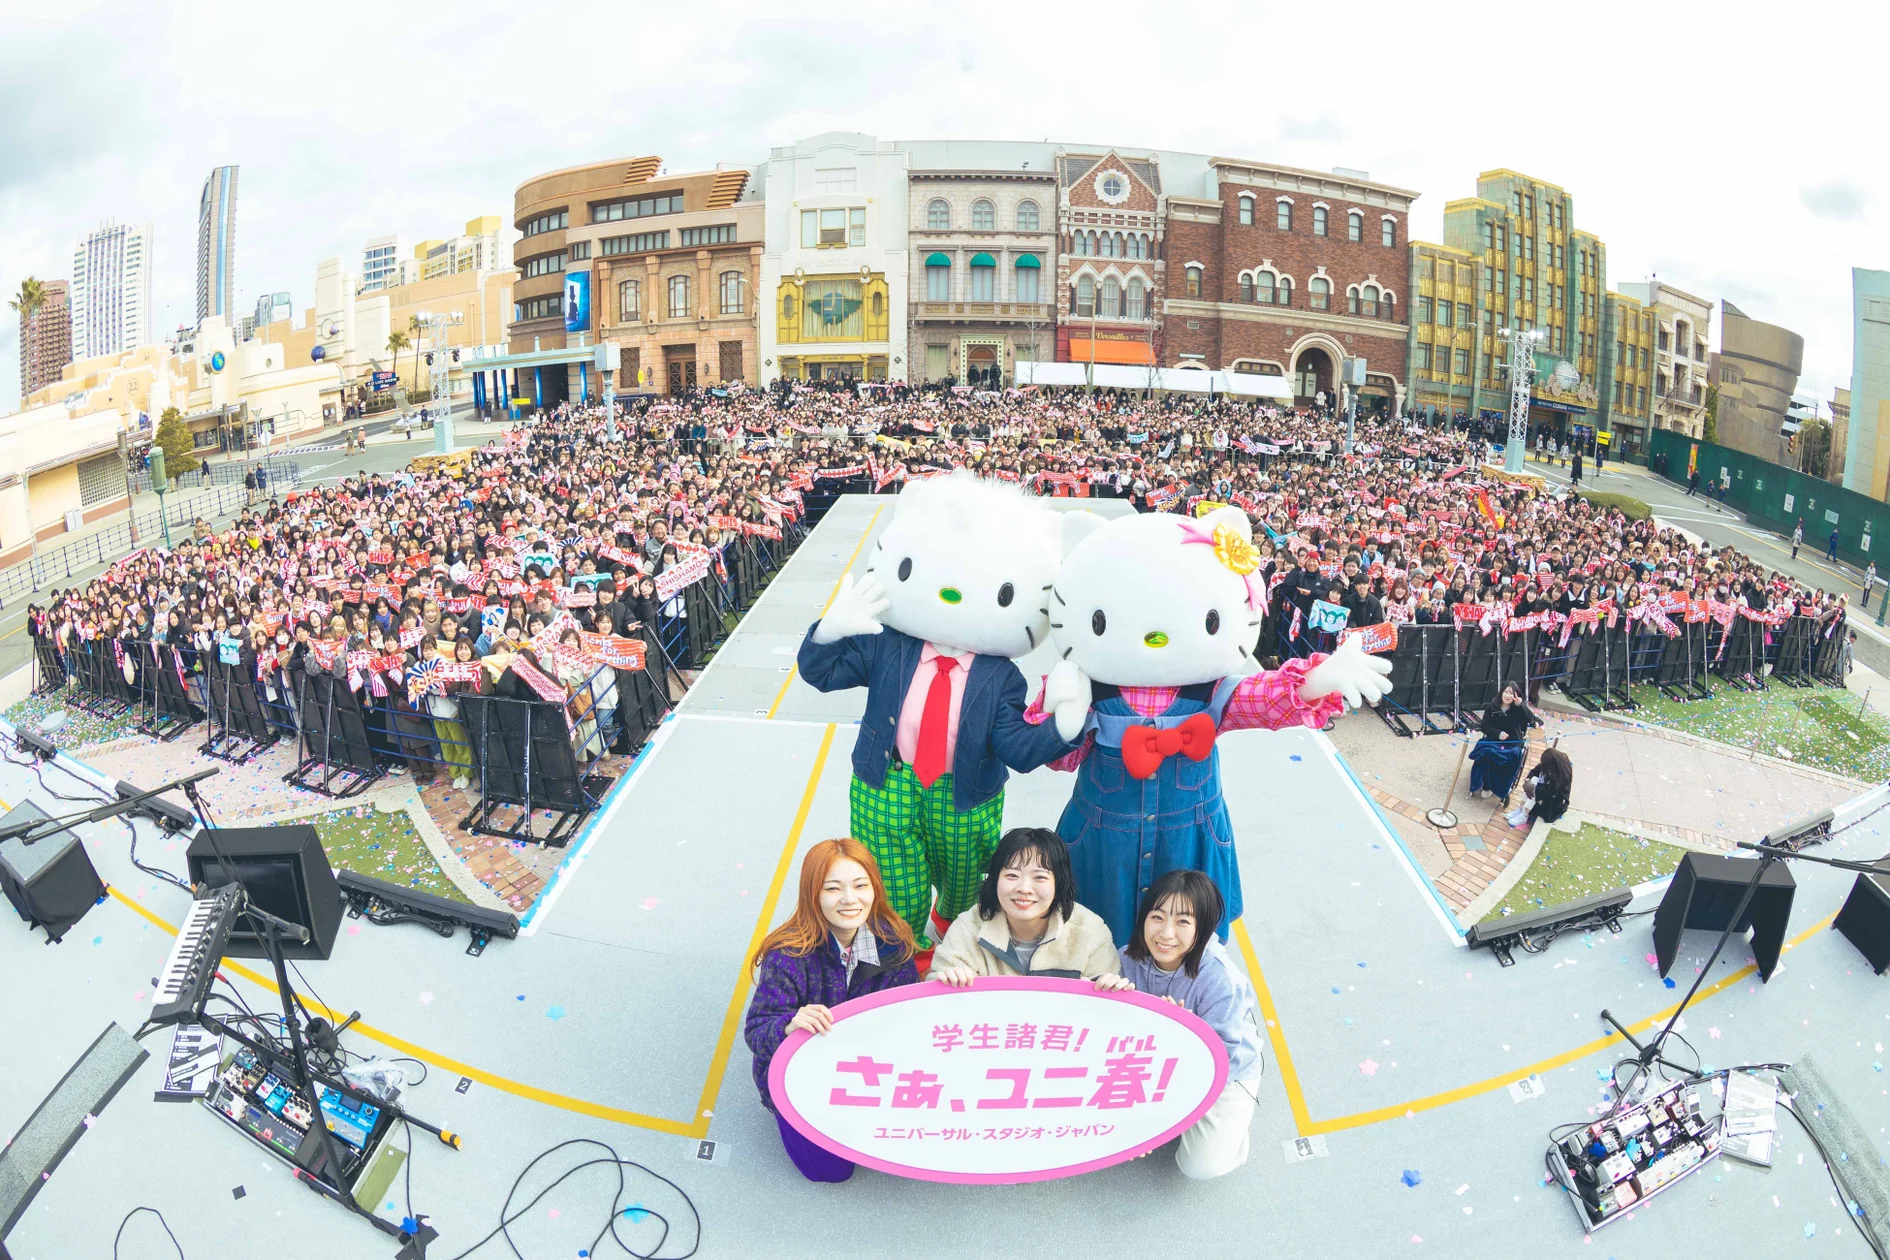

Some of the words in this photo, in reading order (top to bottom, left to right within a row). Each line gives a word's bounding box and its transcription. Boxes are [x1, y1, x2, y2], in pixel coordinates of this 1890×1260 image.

[129, 381, 139, 391] 22
[660, 560, 703, 588] SHISHAMO
[932, 1023, 1090, 1052] 学生諸君!
[1105, 1035, 1157, 1053] バル
[459, 1080, 468, 1091] 2
[874, 1124, 1115, 1141] ユニバーサル・スタジオ・ジャパン
